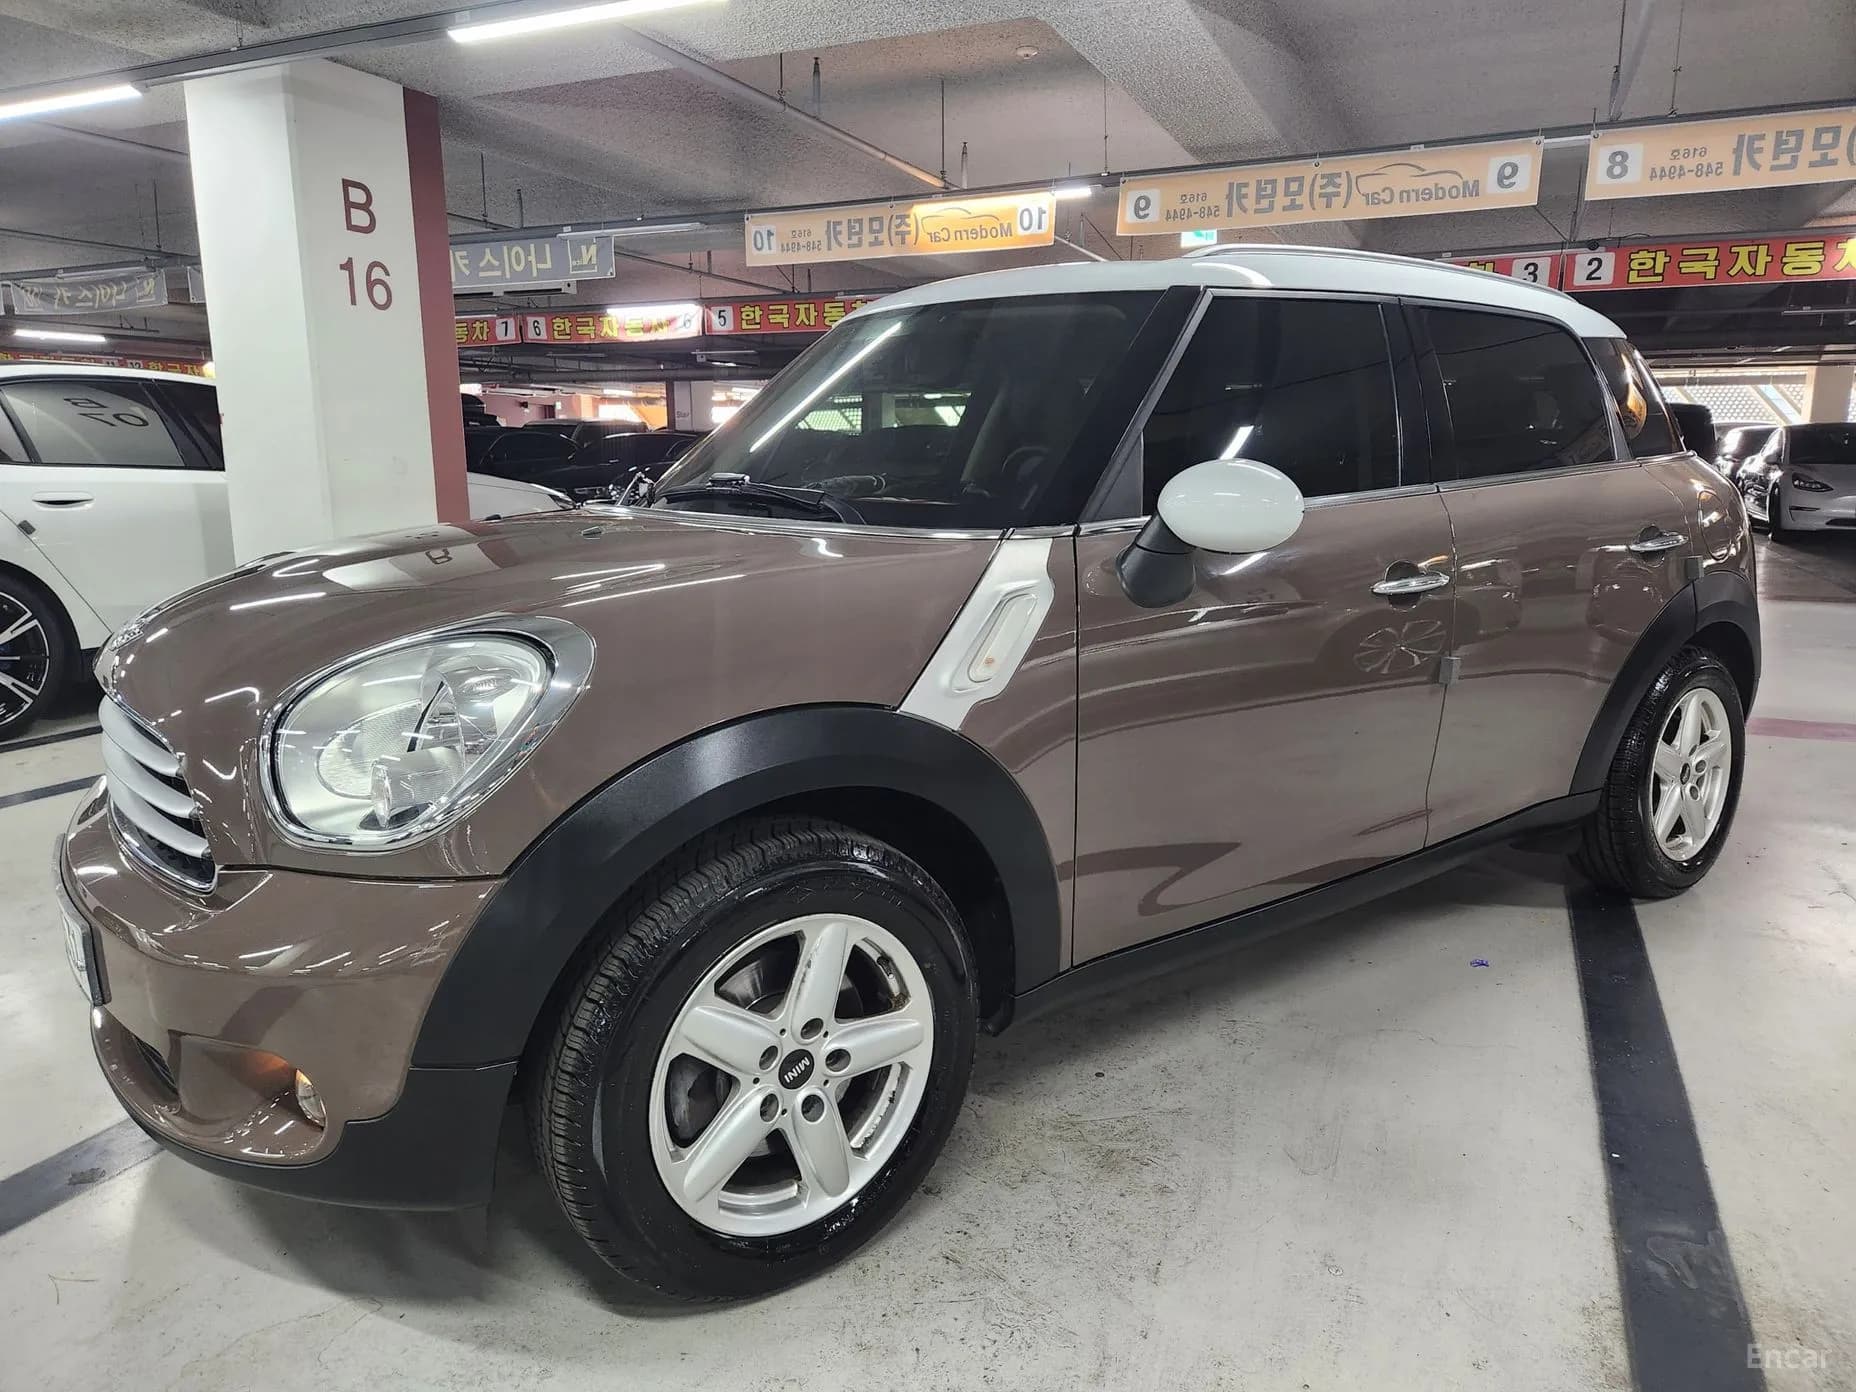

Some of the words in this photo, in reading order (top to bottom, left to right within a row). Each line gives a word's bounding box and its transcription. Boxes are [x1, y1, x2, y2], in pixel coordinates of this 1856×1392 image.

[342, 178, 376, 234] B
[1523, 262, 1538, 283] 3
[1586, 256, 1602, 281] 2
[339, 257, 393, 311] 16
[501, 320, 509, 337] 7
[532, 319, 541, 337] 6
[718, 310, 726, 327] 5
[783, 1056, 811, 1083] MINI
